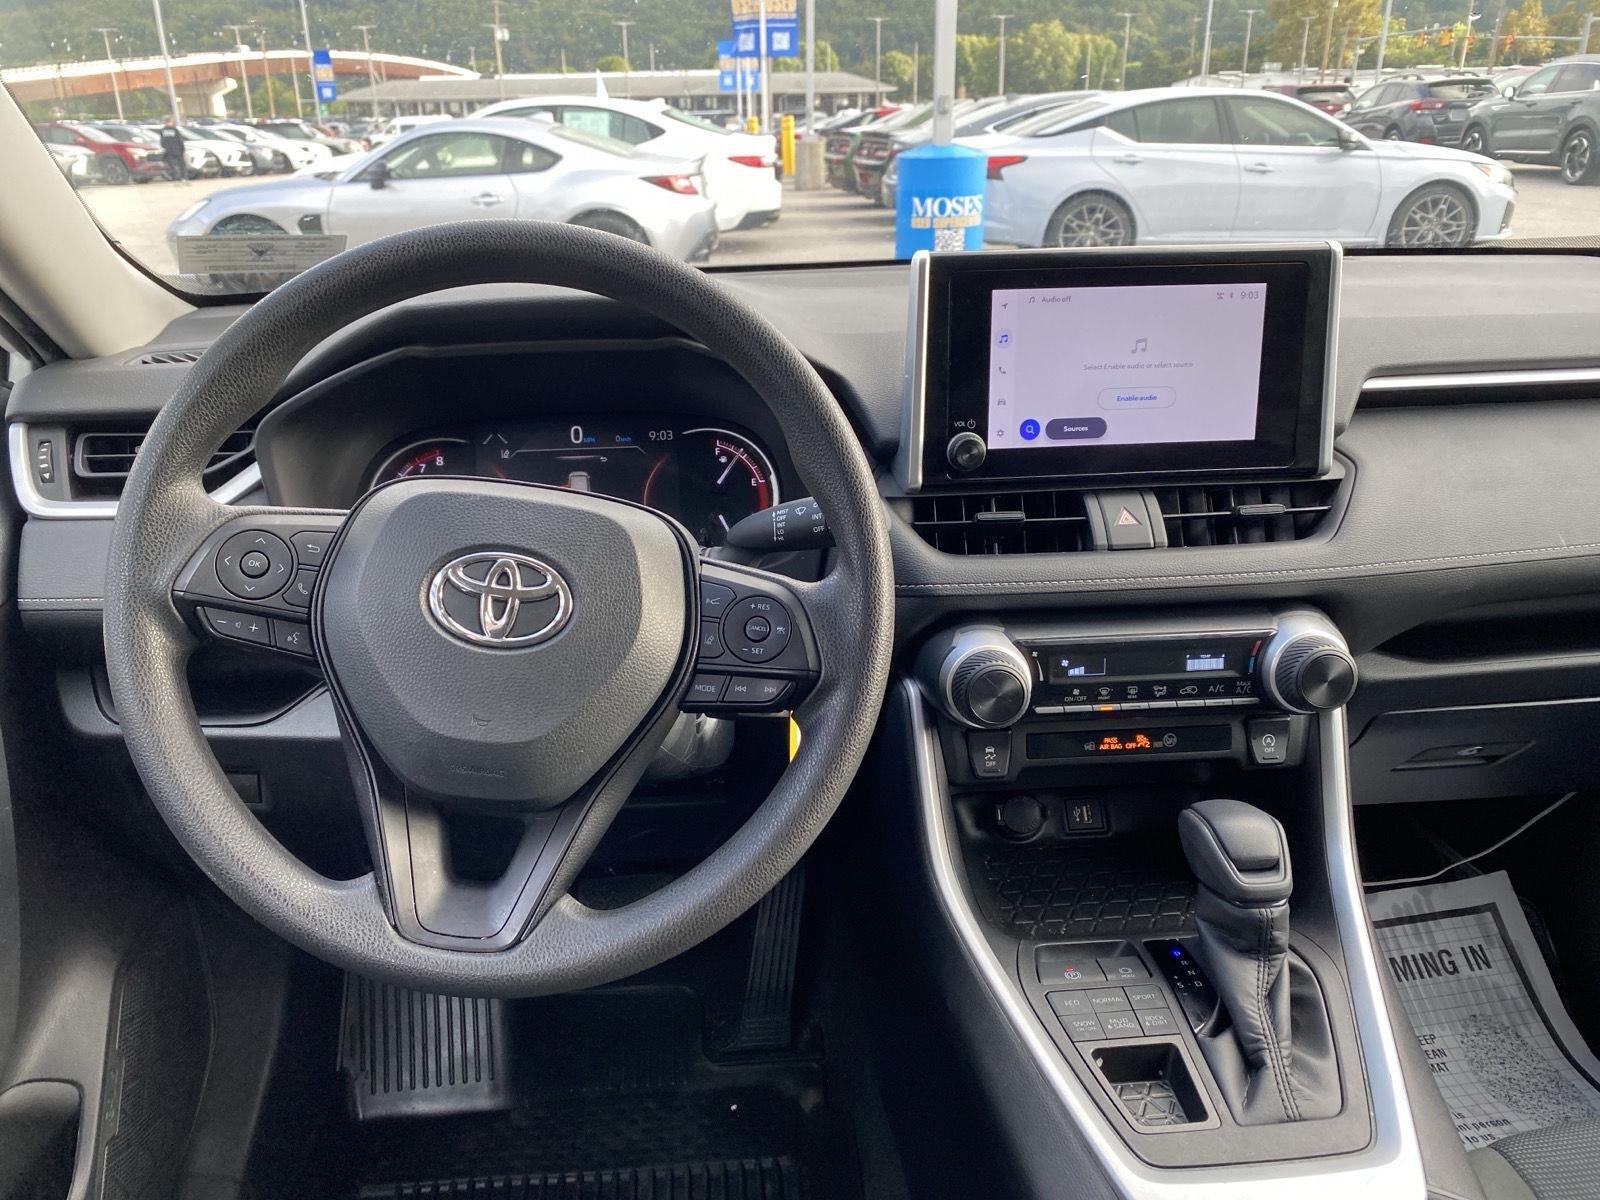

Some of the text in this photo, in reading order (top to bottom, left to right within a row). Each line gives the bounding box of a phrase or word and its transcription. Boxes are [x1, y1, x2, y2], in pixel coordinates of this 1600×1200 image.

[911, 194, 982, 217] MOSES
[1061, 295, 1071, 303] off
[1241, 290, 1259, 300] 9:03
[1127, 361, 1144, 369] audio
[1116, 393, 1157, 402] Enable audio
[570, 425, 583, 444] 0
[648, 430, 673, 441] 9:03
[715, 447, 721, 456] F
[435, 456, 444, 466] 8
[418, 463, 426, 473] 7
[751, 478, 757, 487] E
[811, 512, 823, 520] INT
[813, 525, 825, 533] OFF
[248, 560, 261, 568] OK
[757, 603, 771, 611] RES
[751, 647, 764, 655] SET
[694, 685, 716, 693] MODE
[1208, 684, 1225, 693] A/C
[1235, 686, 1252, 694] A/C
[1110, 742, 1123, 750] BAG
[1388, 944, 1492, 983] MING IN
[1092, 996, 1123, 1004] NORMAL
[1132, 993, 1155, 1001] SPORT
[1471, 1118, 1511, 1132] person
